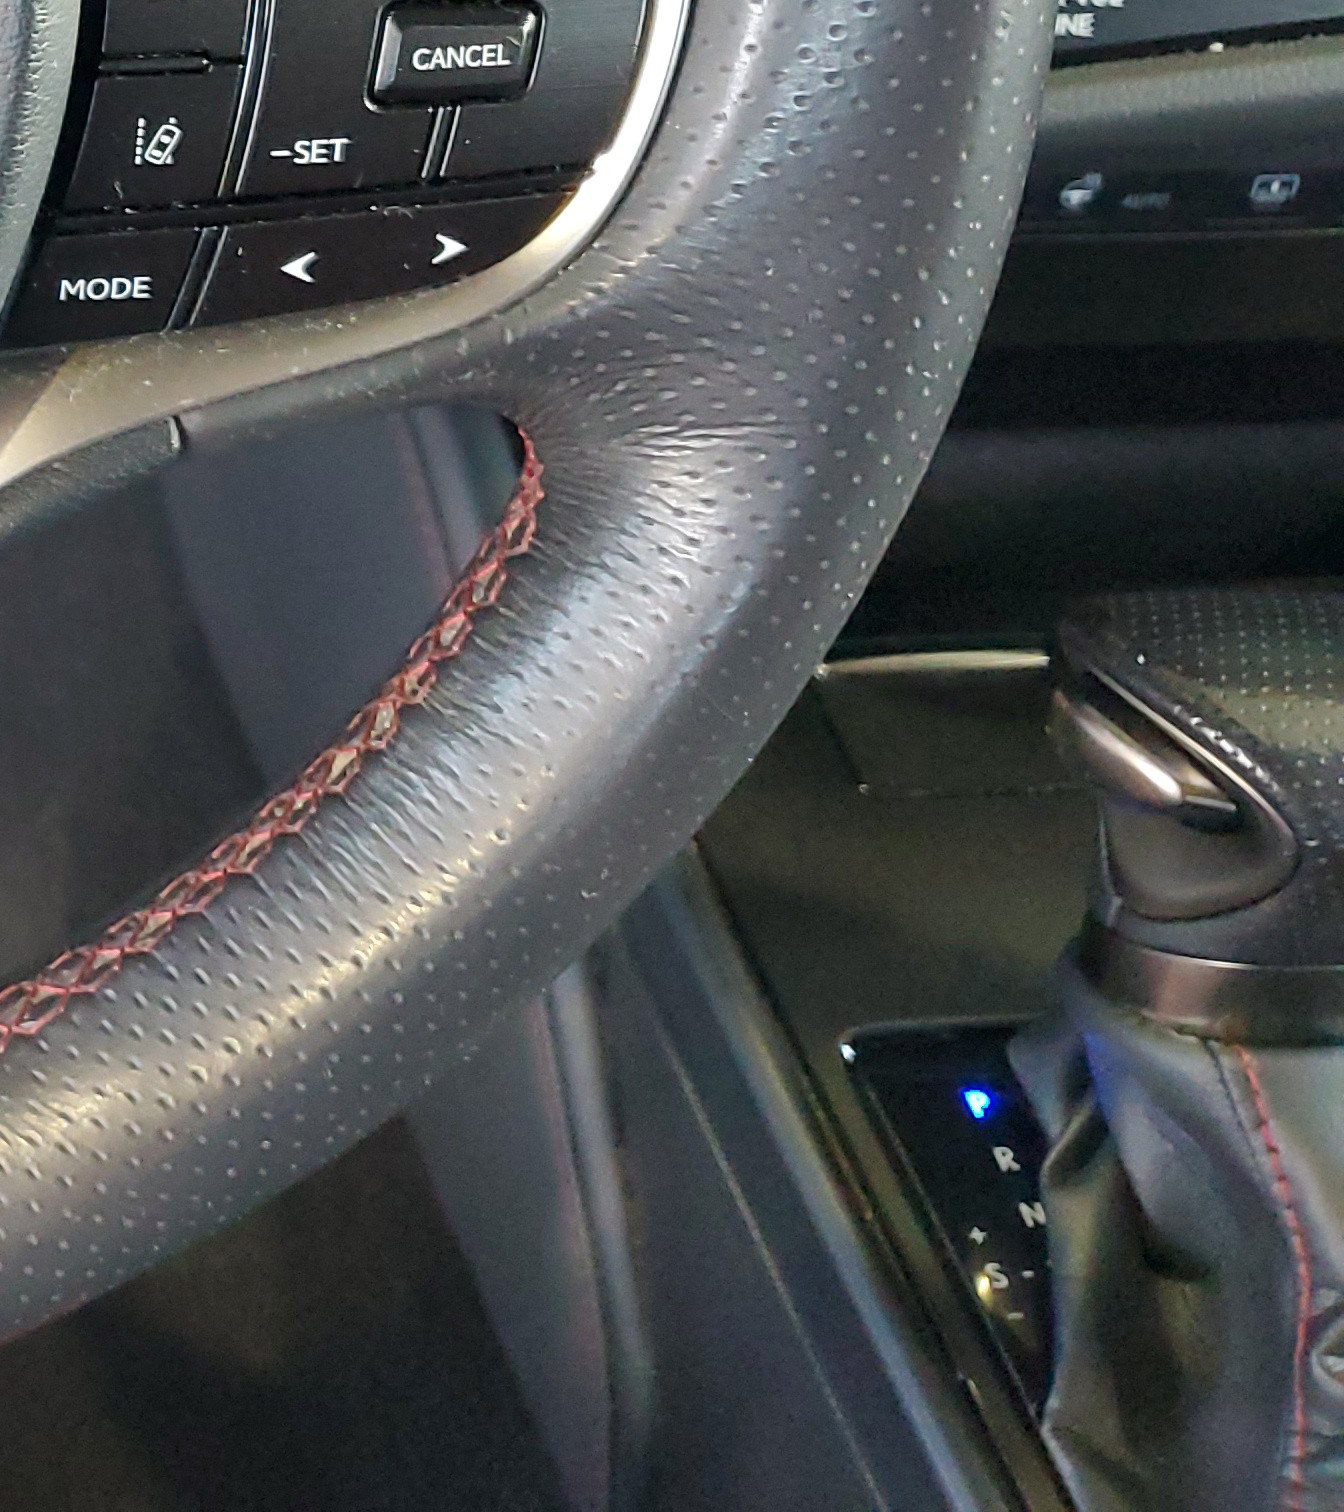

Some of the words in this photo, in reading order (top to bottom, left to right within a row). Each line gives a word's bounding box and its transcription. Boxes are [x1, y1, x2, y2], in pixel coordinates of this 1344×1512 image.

[413, 45, 512, 70] CANCEL
[59, 276, 152, 302] MODE
[964, 1089, 991, 1119] P
[993, 1146, 1021, 1172] R
[1018, 1201, 1047, 1229] N
[985, 1262, 1010, 1288] S
